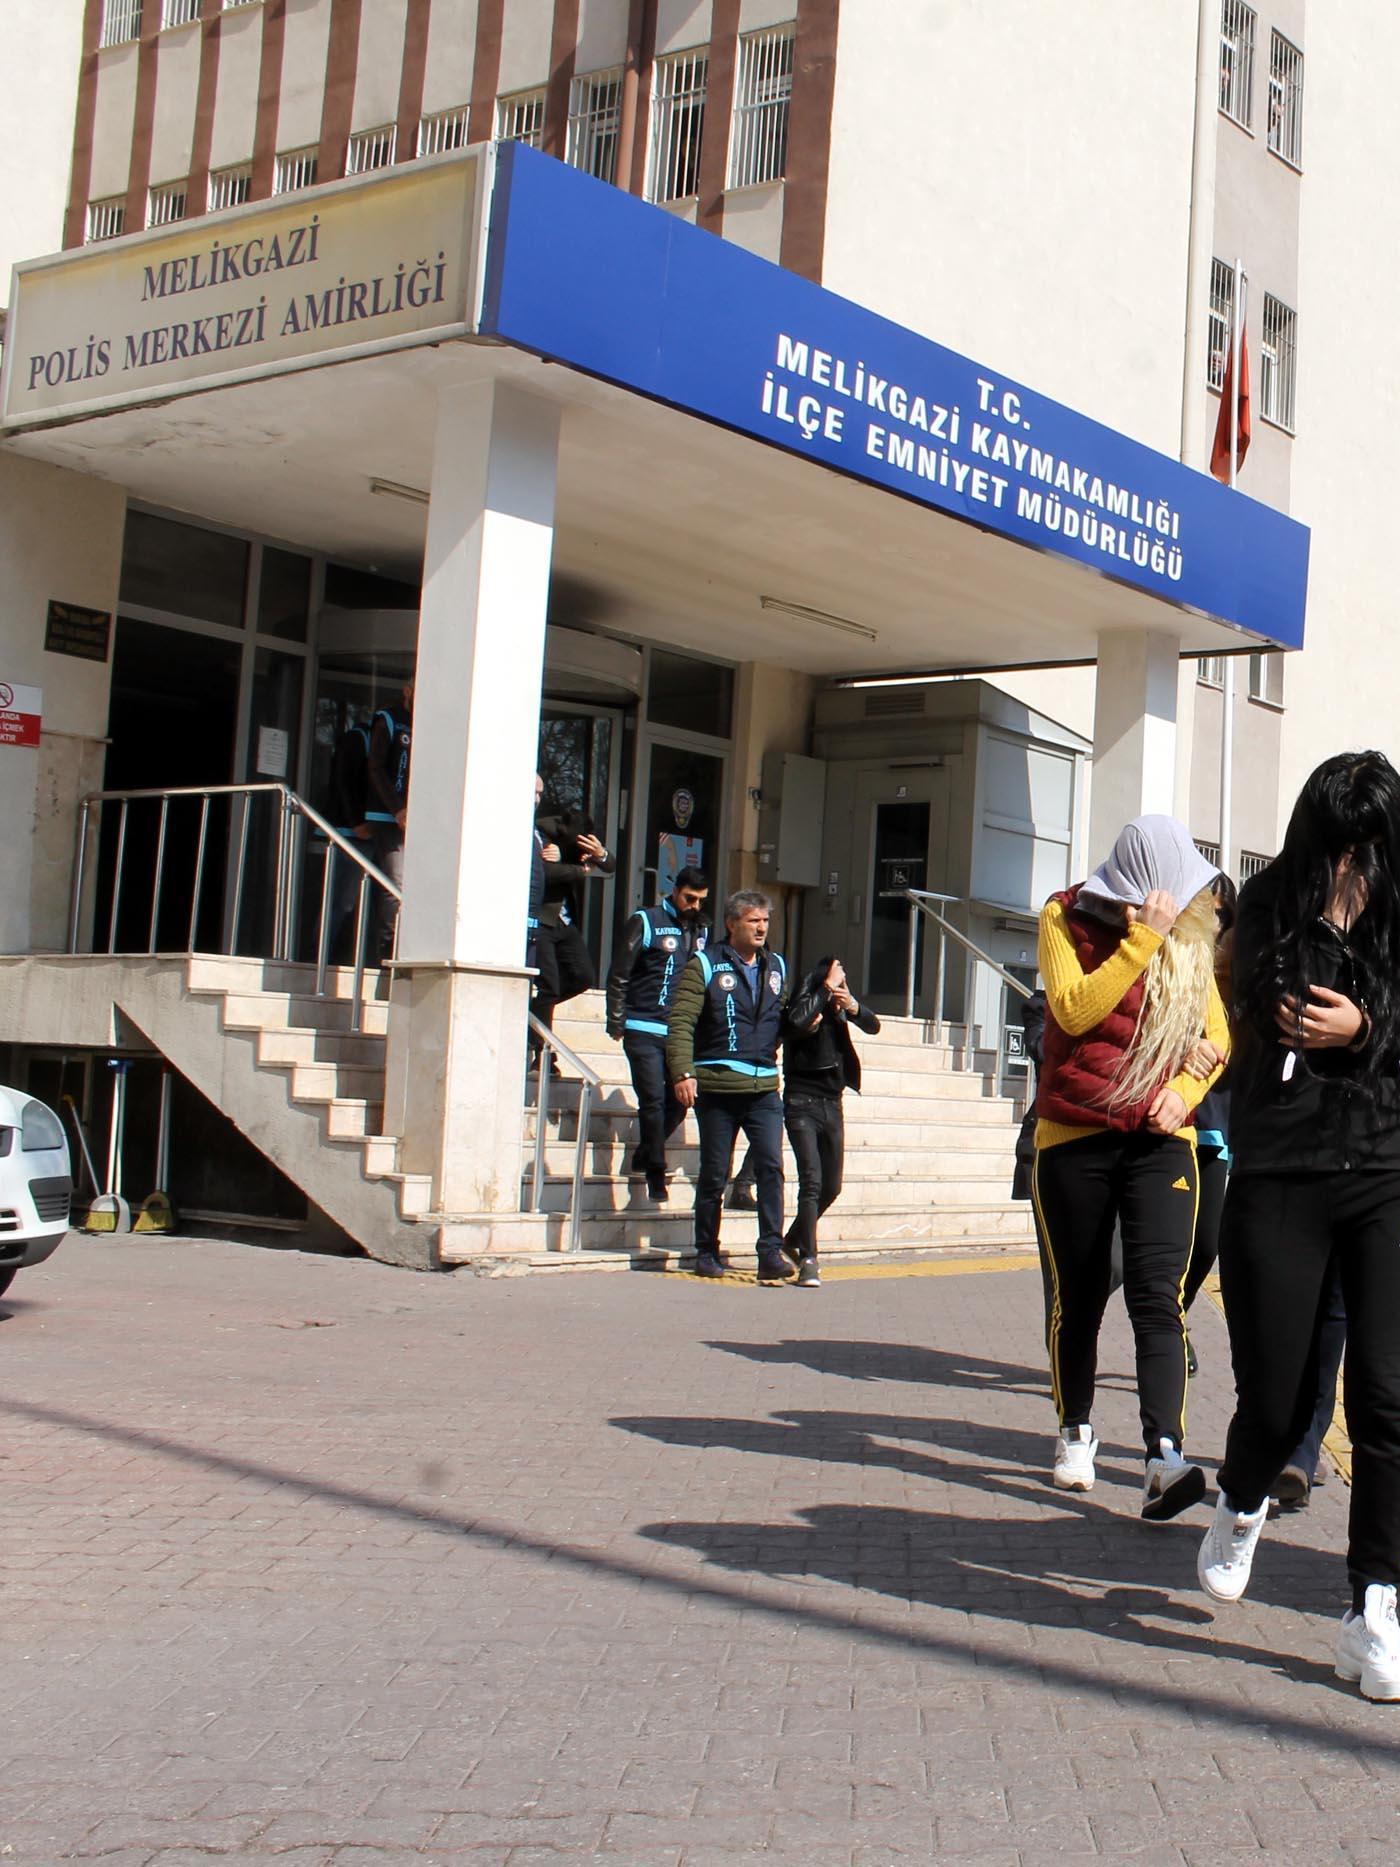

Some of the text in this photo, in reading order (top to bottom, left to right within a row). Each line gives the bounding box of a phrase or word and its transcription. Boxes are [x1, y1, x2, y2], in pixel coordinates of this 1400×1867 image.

[141, 214, 321, 302] MELİKGAZİ
[27, 251, 447, 391] POLİS MERKEZİ AMİRLİĞİ
[776, 334, 1180, 540] MELİKGAZİ KAYMAKAMLIĞI
[976, 378, 1032, 430] T.C.
[761, 371, 1184, 582] İLÇE EMNİYET MÜDÜRLÜĞÜ
[658, 954, 674, 1007] AHLAK
[726, 993, 738, 1052] AHLAK
